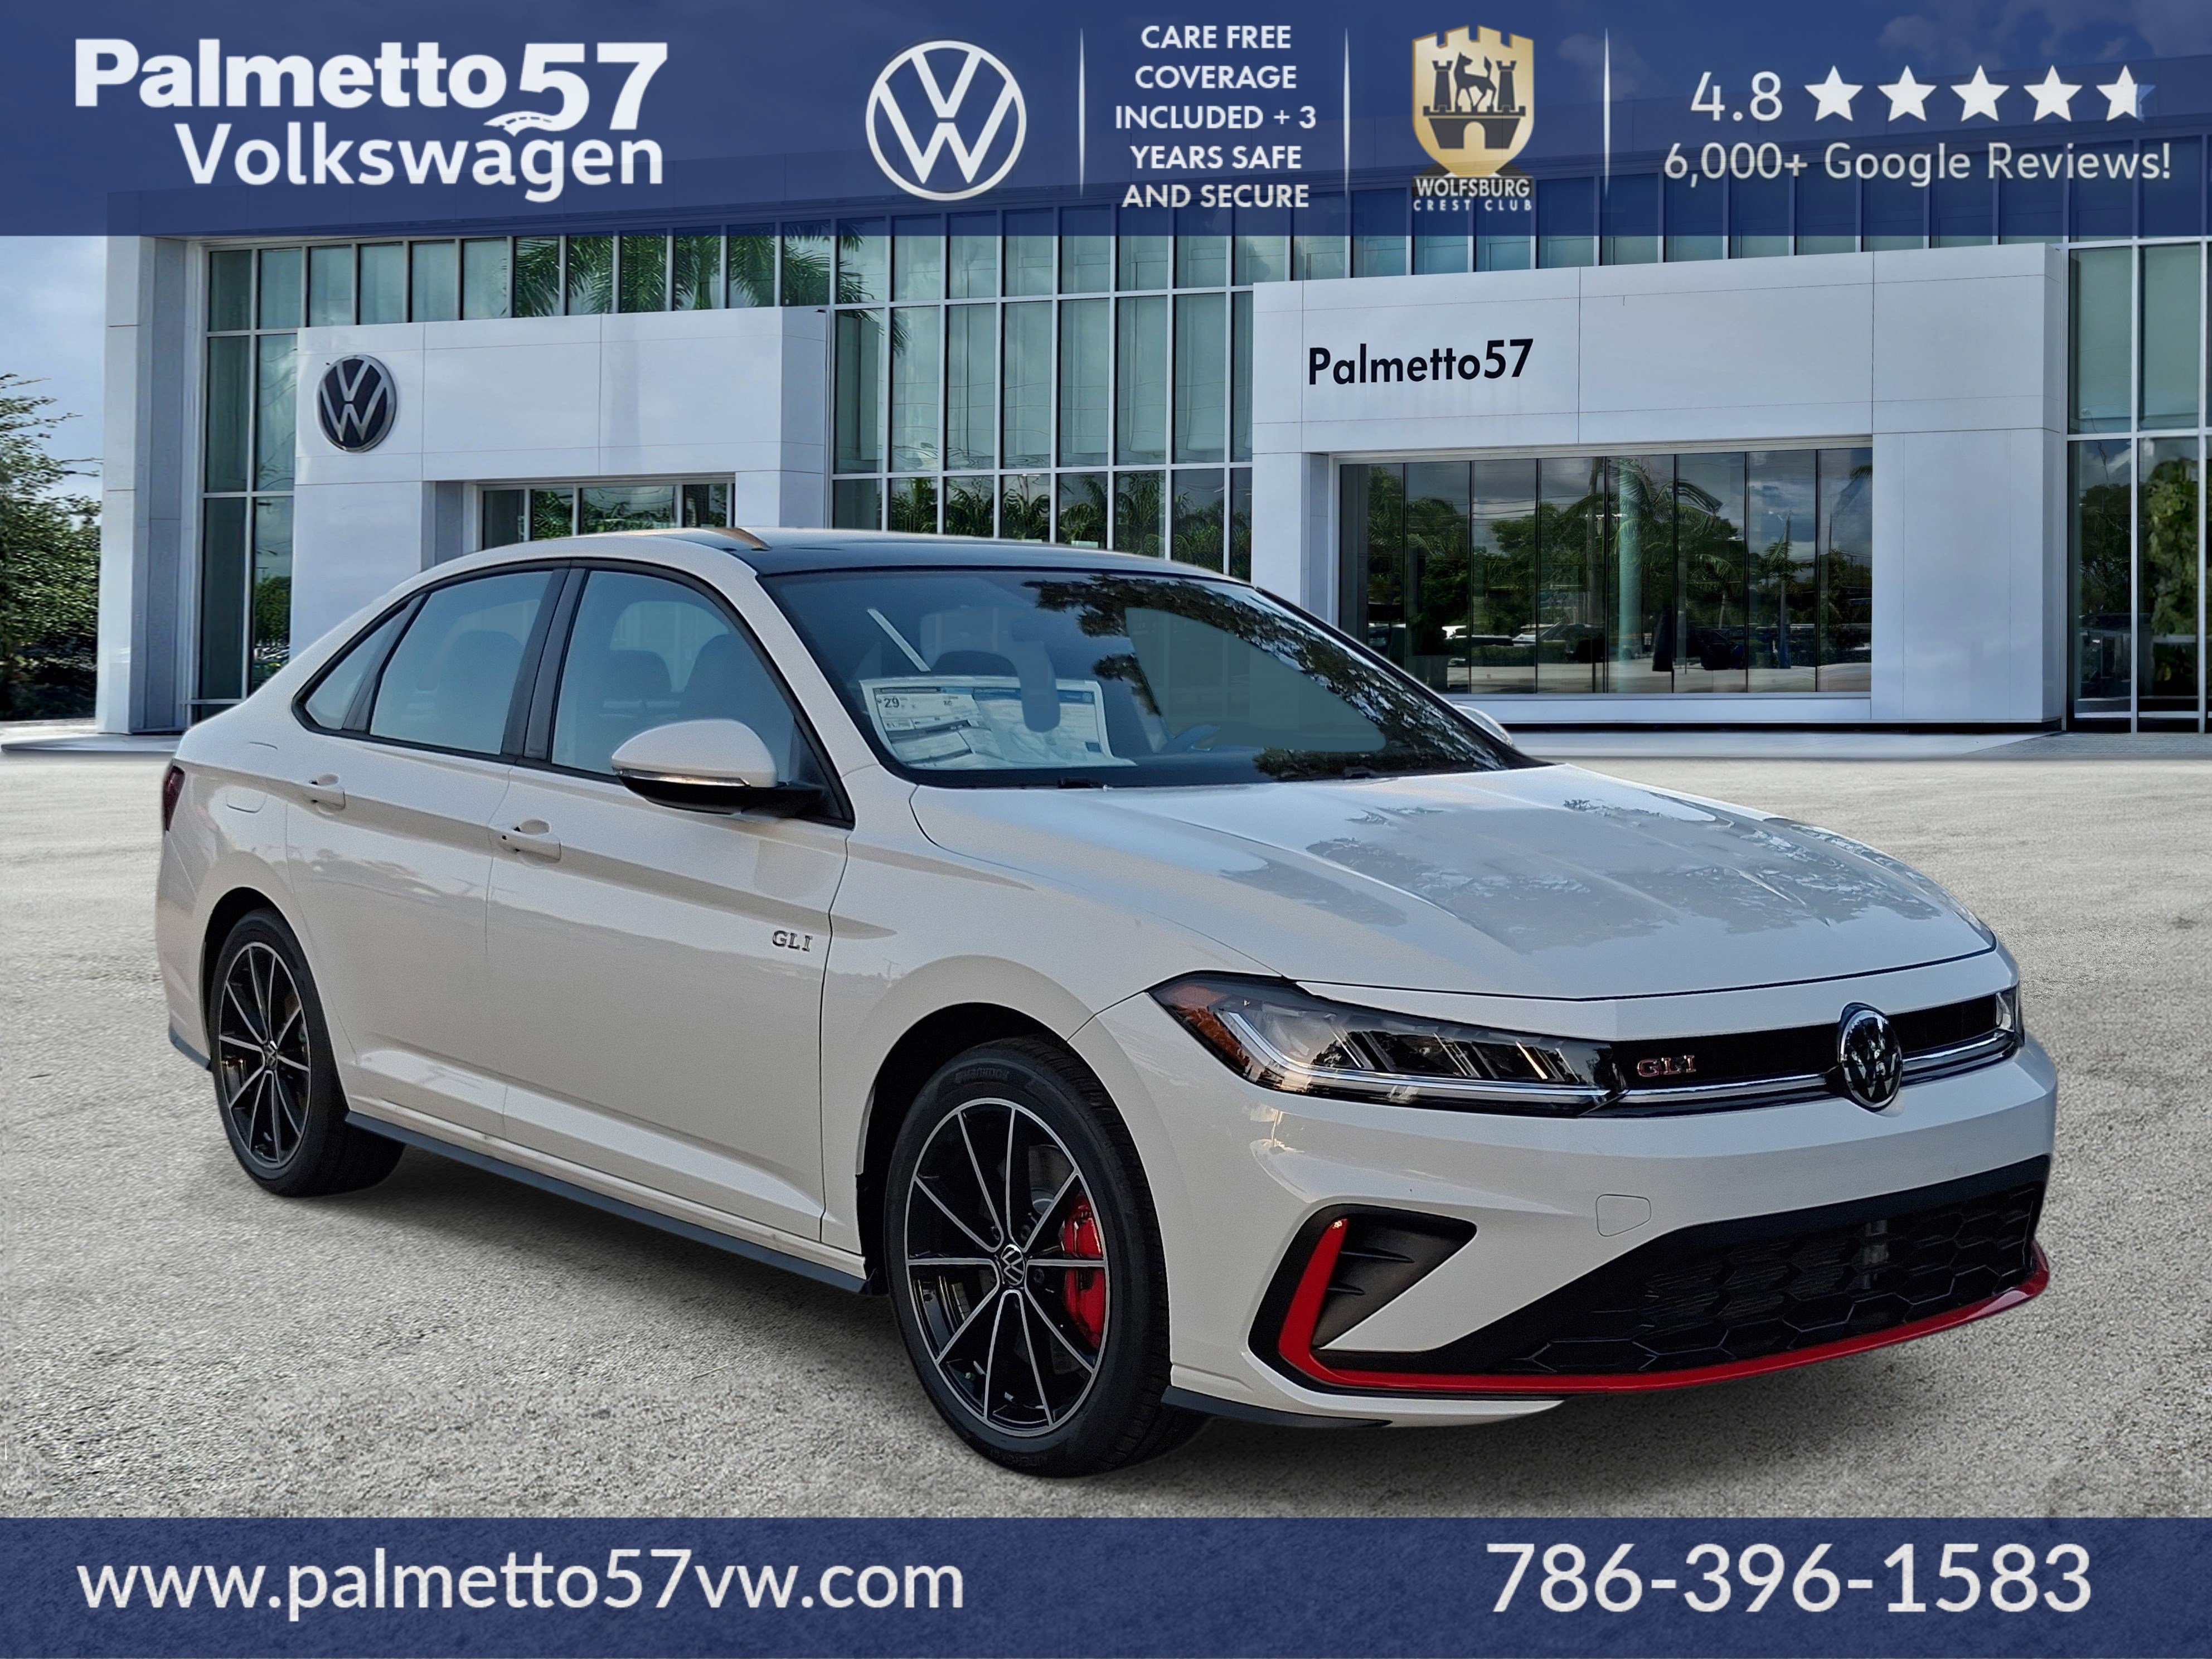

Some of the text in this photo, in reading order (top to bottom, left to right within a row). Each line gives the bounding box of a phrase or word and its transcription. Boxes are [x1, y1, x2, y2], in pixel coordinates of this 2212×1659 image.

[1309, 338, 1534, 385] Palmetto57
[883, 697, 900, 708] 29
[772, 930, 813, 952] GLI
[1637, 1055, 1696, 1078] GLI
